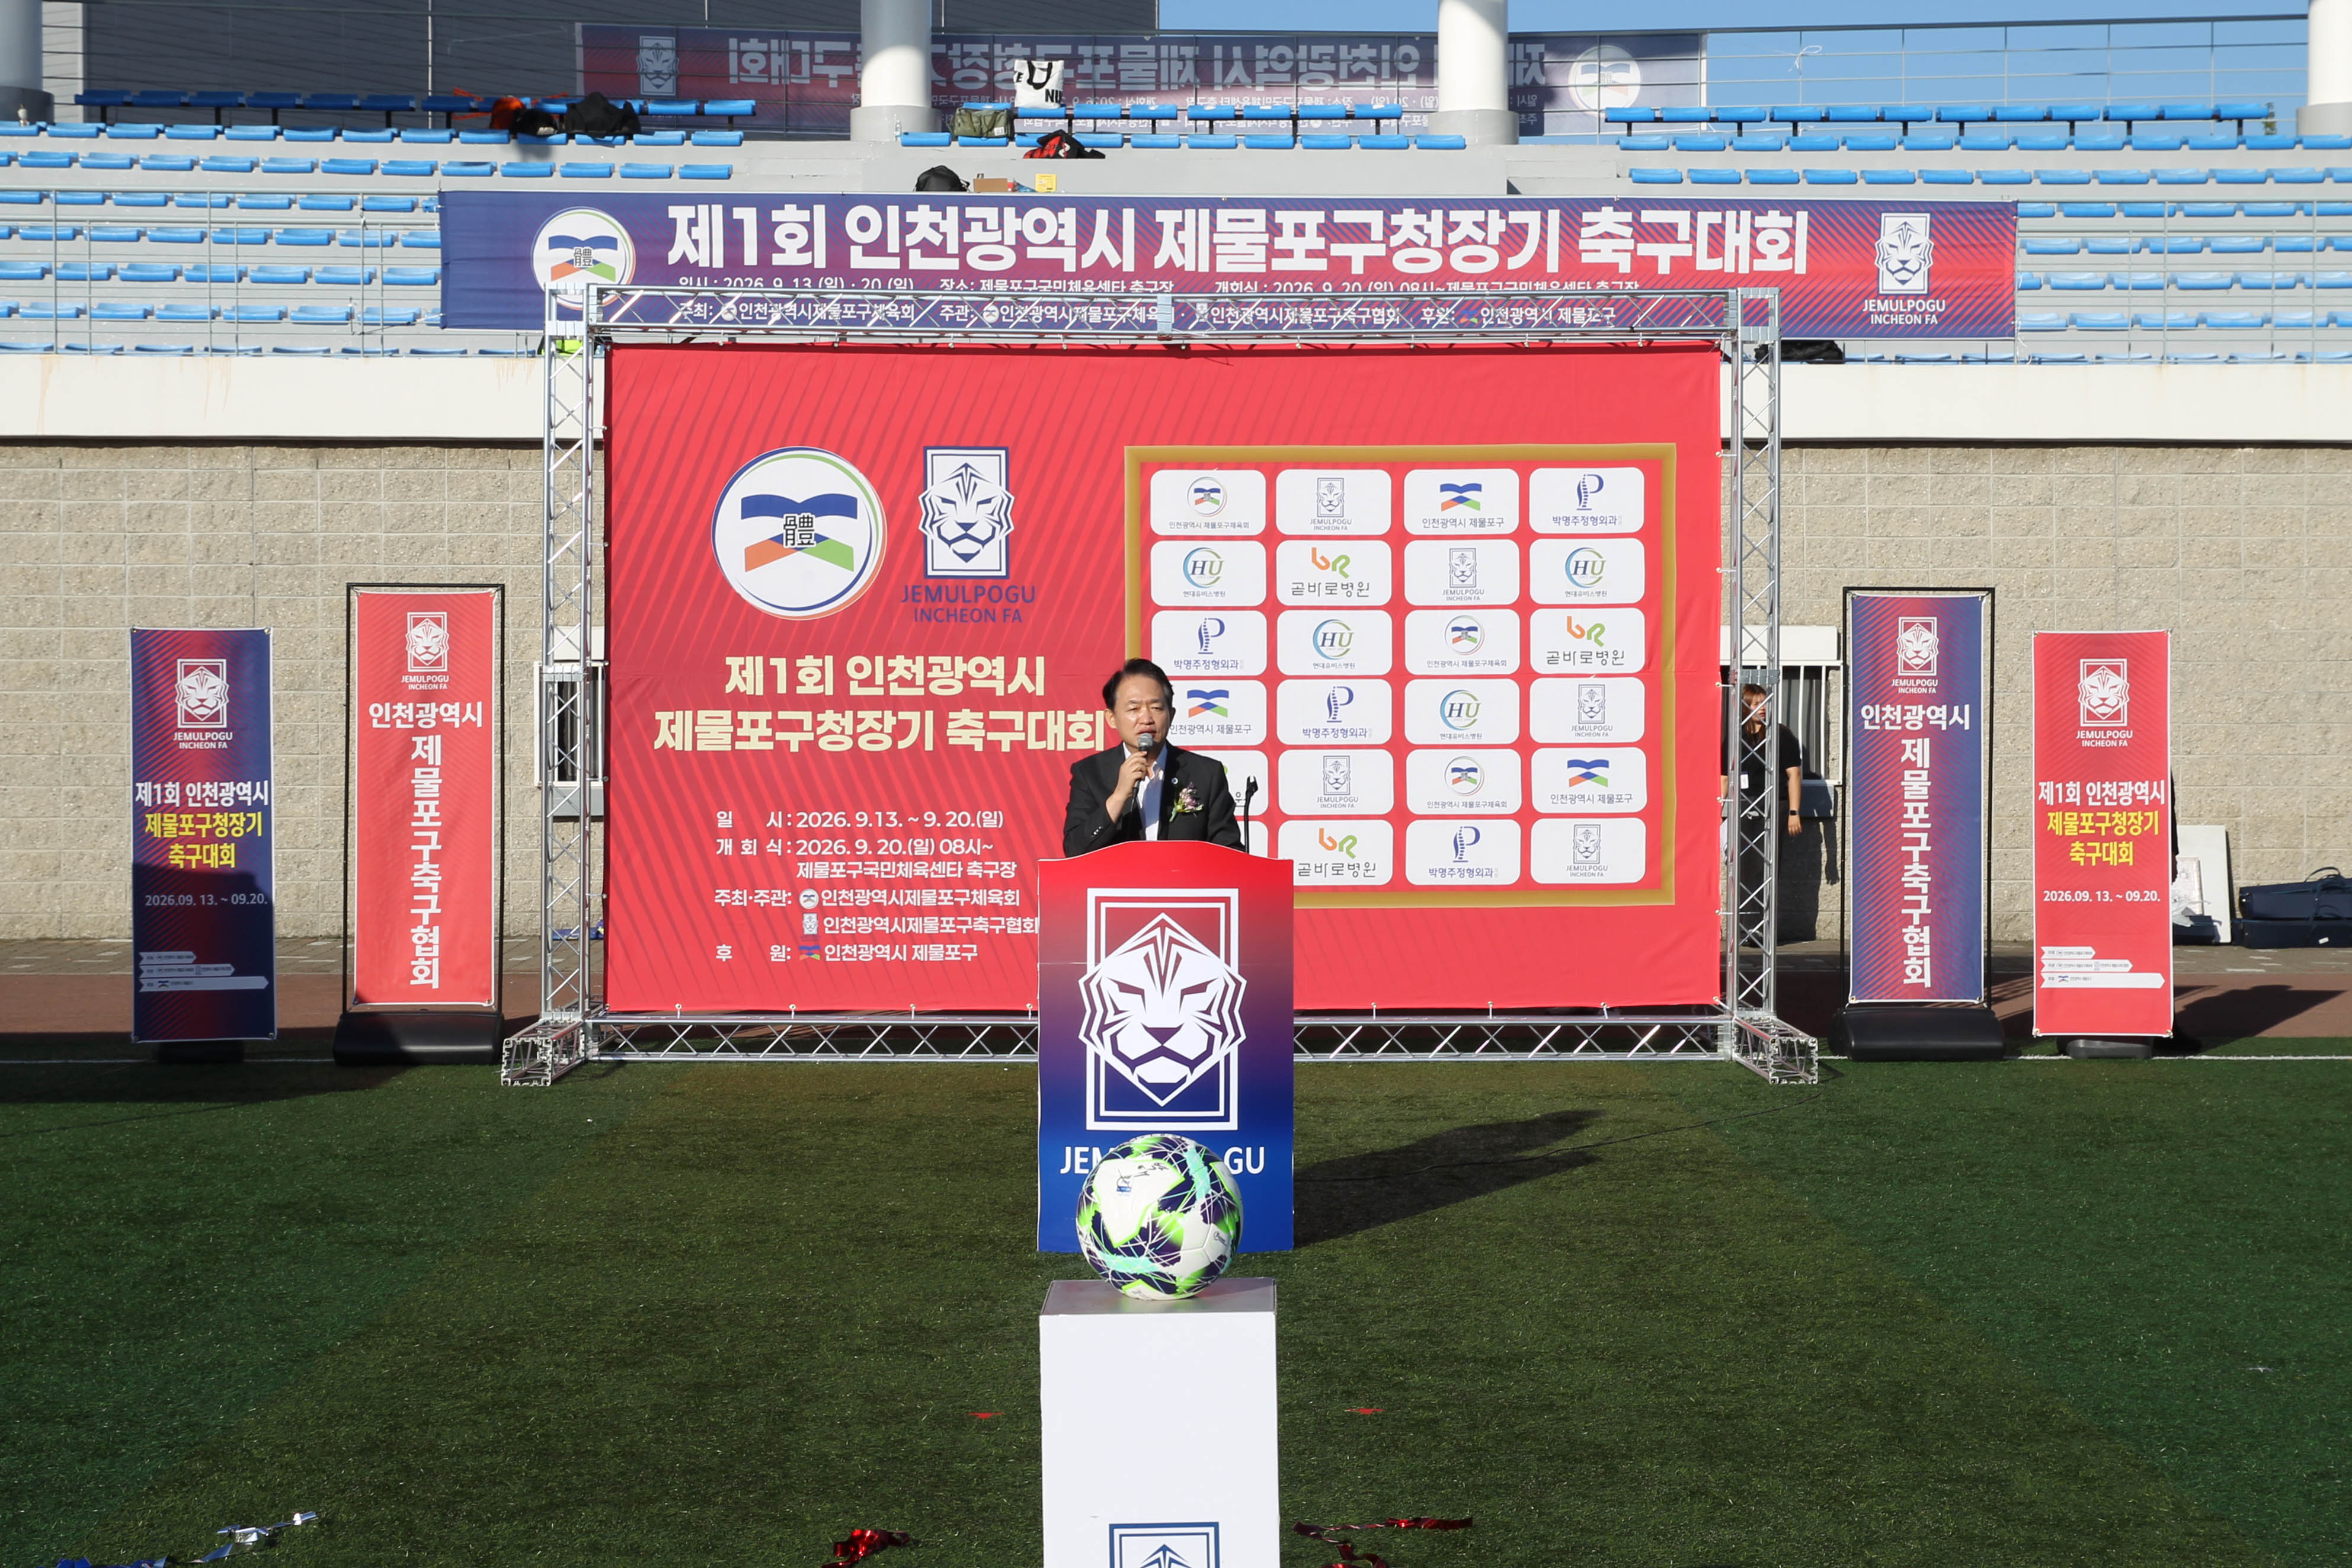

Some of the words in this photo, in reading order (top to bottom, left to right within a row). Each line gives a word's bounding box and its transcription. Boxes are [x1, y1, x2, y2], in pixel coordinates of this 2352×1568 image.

[668, 204, 825, 268] 제1회
[846, 205, 1134, 272] 인천광역시
[1154, 209, 1560, 274] 제물포구청장기
[1579, 207, 1808, 274] 축구대회
[574, 248, 593, 266] 體
[1863, 300, 1945, 312] JEMULPOGU
[1001, 306, 1175, 324] 인천광역시제물포구체육
[1871, 314, 1919, 324] INCHEON
[1919, 315, 1938, 324] FA
[1310, 517, 1352, 526] JEMULPOGU
[1422, 518, 1465, 529] 인천광역시
[1470, 518, 1504, 527] 제물포구
[1553, 516, 1617, 526] 박명주정형외과
[783, 514, 815, 548] 體
[902, 585, 1035, 604] JEMULPOGU
[1291, 582, 1369, 597] 곧바로병원
[915, 608, 996, 623] INCHEON
[1003, 609, 1022, 623] FA
[1174, 660, 1239, 670] 박명주정형외과
[1547, 650, 1624, 665] 곧바로병원
[725, 655, 833, 695] 제1회
[847, 655, 1044, 696] 인천광역시
[369, 702, 482, 728] 인천광역시
[1861, 705, 1969, 730] 인천광역시
[174, 732, 232, 740] JEMULPOGU
[654, 710, 933, 752] 제물포구청장기
[946, 709, 1105, 751] 축구대회
[1170, 725, 1213, 735] 인천광역시
[1217, 724, 1252, 734] 제물포구
[1303, 728, 1367, 738] 박명주정형외과
[2076, 730, 2133, 738] JEMULPOGU
[136, 782, 180, 807] 제1회
[186, 780, 268, 807] 인천광역시
[1551, 794, 1594, 805] 인천광역시
[1598, 794, 1633, 804] 제물포구
[2039, 781, 2080, 805] 제1회
[2086, 780, 2164, 805] 인천광역시
[145, 812, 263, 838] 제물포구청장기
[796, 812, 850, 827] 2026.
[924, 812, 940, 827] 9.
[2047, 811, 2159, 836] 제물포구청장기
[796, 840, 850, 855] 2026.
[855, 839, 872, 855] 9.
[940, 839, 993, 855] 08시~
[2070, 841, 2133, 866] 축구대회
[169, 843, 235, 869] 축구대회
[410, 735, 443, 988] 제물포구축구협회
[1901, 738, 1931, 988] 제물포구축구협회
[797, 862, 963, 878] 제물포구국민체육센터
[967, 861, 1017, 878] 축구장
[1298, 862, 1375, 878] 곧바로병원
[1429, 868, 1493, 878] 박명주정형외과
[145, 895, 196, 906] 2026.09.
[200, 895, 217, 905] 13.
[231, 894, 267, 905] 09.20.
[821, 889, 1019, 905] 인천광역시제물포구체육회
[2044, 891, 2092, 901] 2026.09.
[2096, 891, 2113, 901] 13.
[2126, 891, 2160, 901] 09.20.
[823, 917, 1038, 935] 인천광역시제물포구축구협회
[825, 945, 906, 961] 인천광역시
[912, 945, 977, 961] 제물포구
